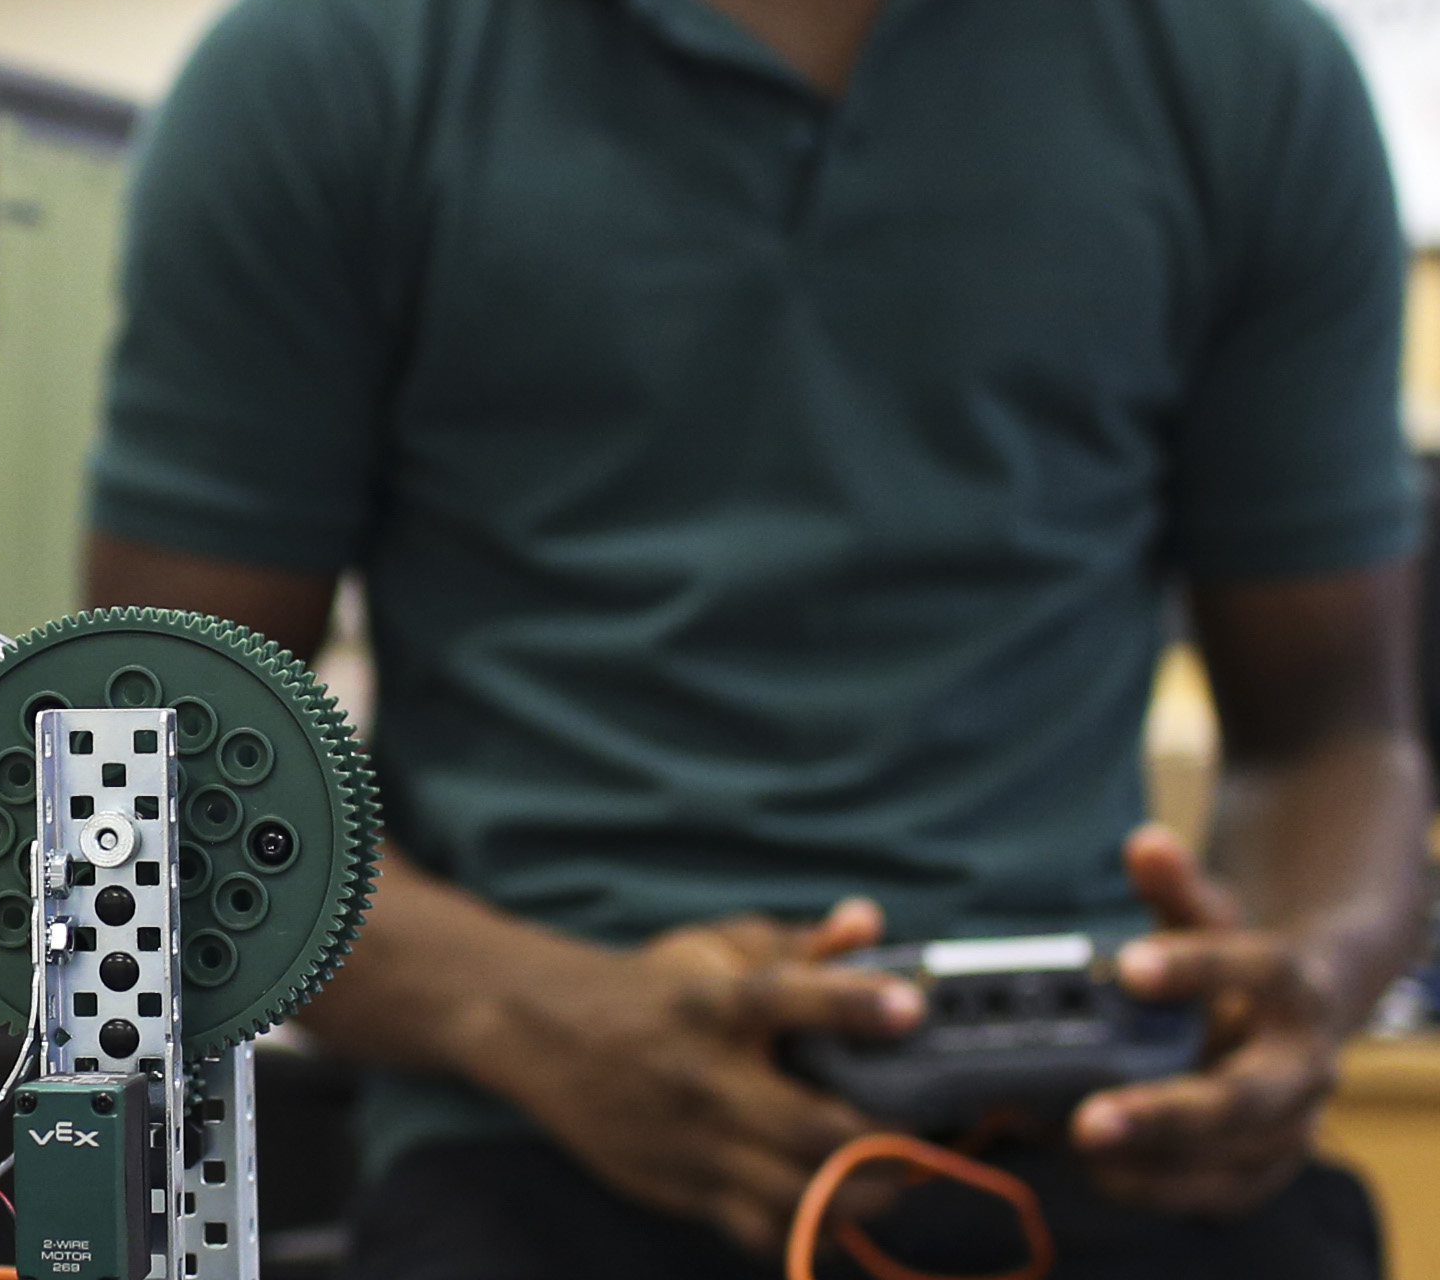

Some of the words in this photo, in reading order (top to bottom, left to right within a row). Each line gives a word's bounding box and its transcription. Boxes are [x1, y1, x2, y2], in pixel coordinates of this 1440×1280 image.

[28, 1121, 100, 1147] VEX
[41, 1251, 92, 1261] MOTOR
[52, 1262, 80, 1272] 269
